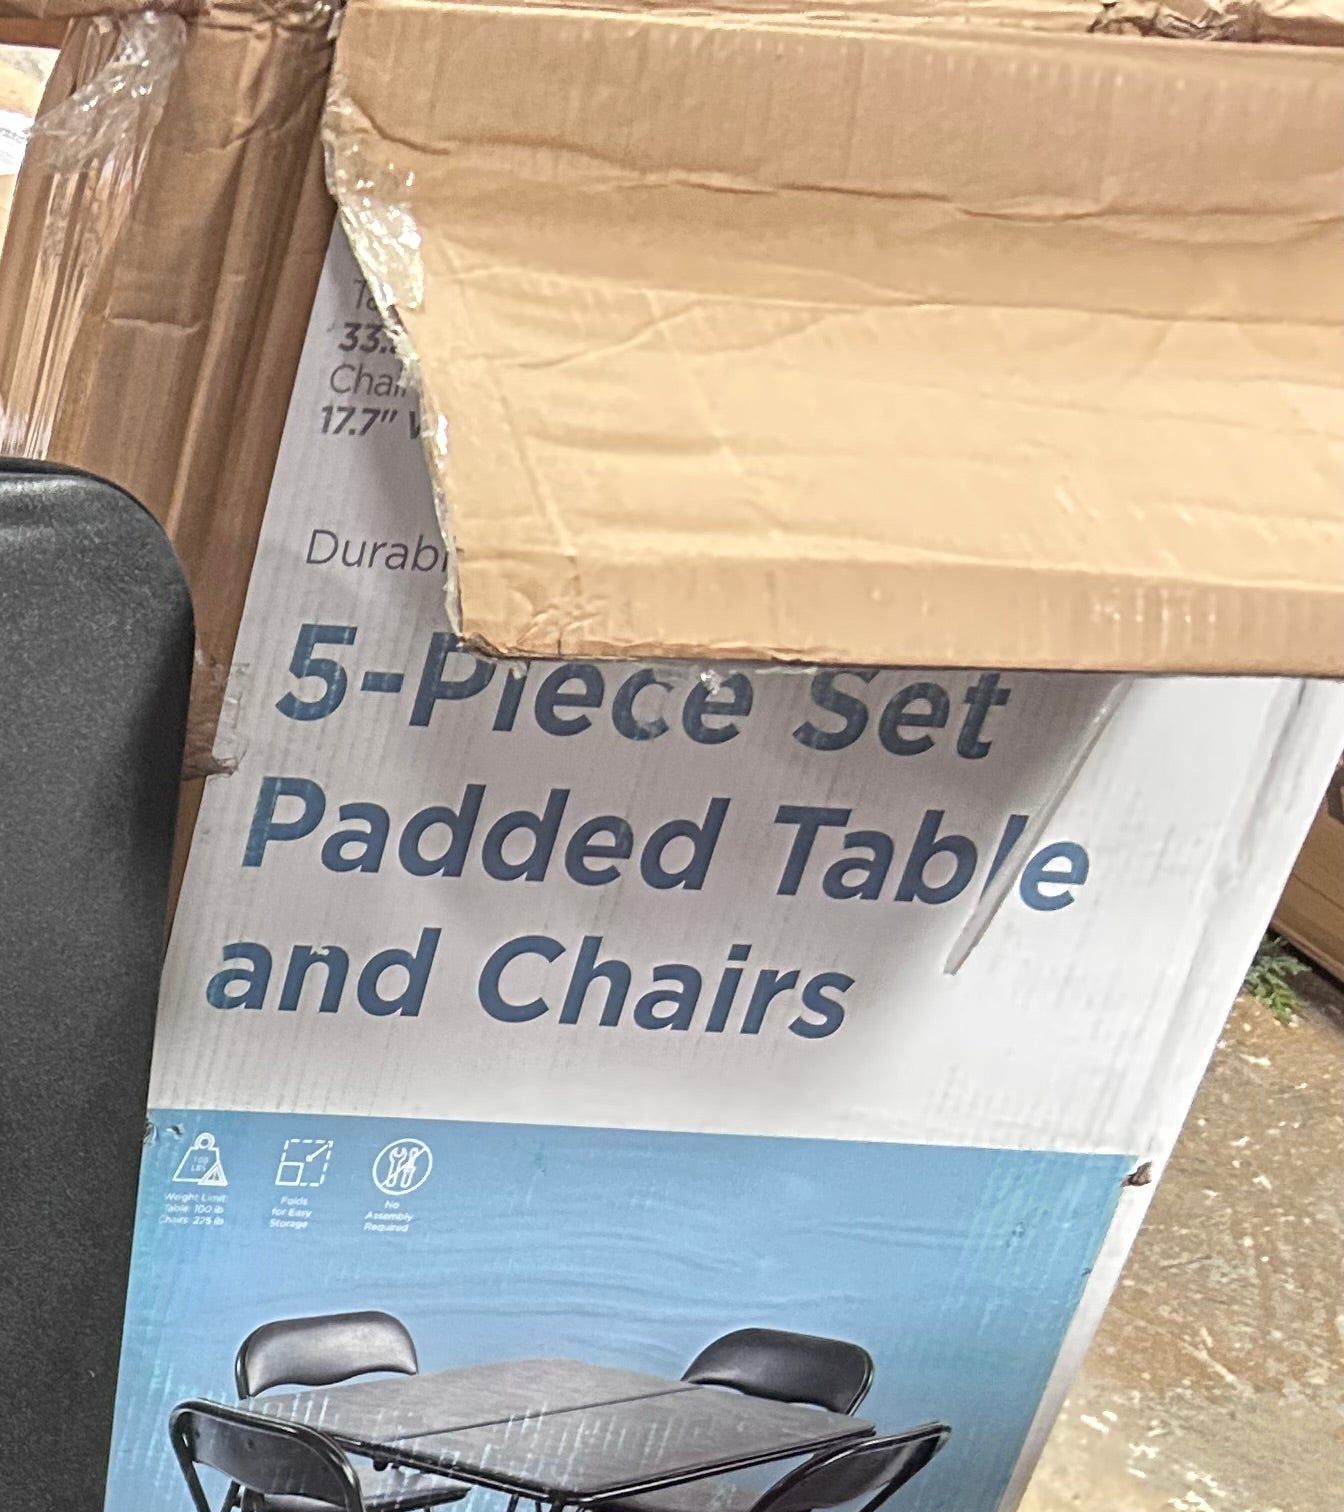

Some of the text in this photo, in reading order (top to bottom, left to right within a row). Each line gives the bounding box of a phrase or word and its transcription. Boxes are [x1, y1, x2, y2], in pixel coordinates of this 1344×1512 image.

[275, 622, 1012, 760] 5-Piece Set
[241, 775, 1090, 912] Padded Table
[205, 926, 856, 1039] and Chairs
[280, 1196, 309, 1206] Folds
[384, 1199, 400, 1210] No
[271, 1206, 313, 1219] for Easy
[363, 1210, 415, 1223] Assembly
[269, 1217, 309, 1230] Storage
[363, 1222, 410, 1232] Required
